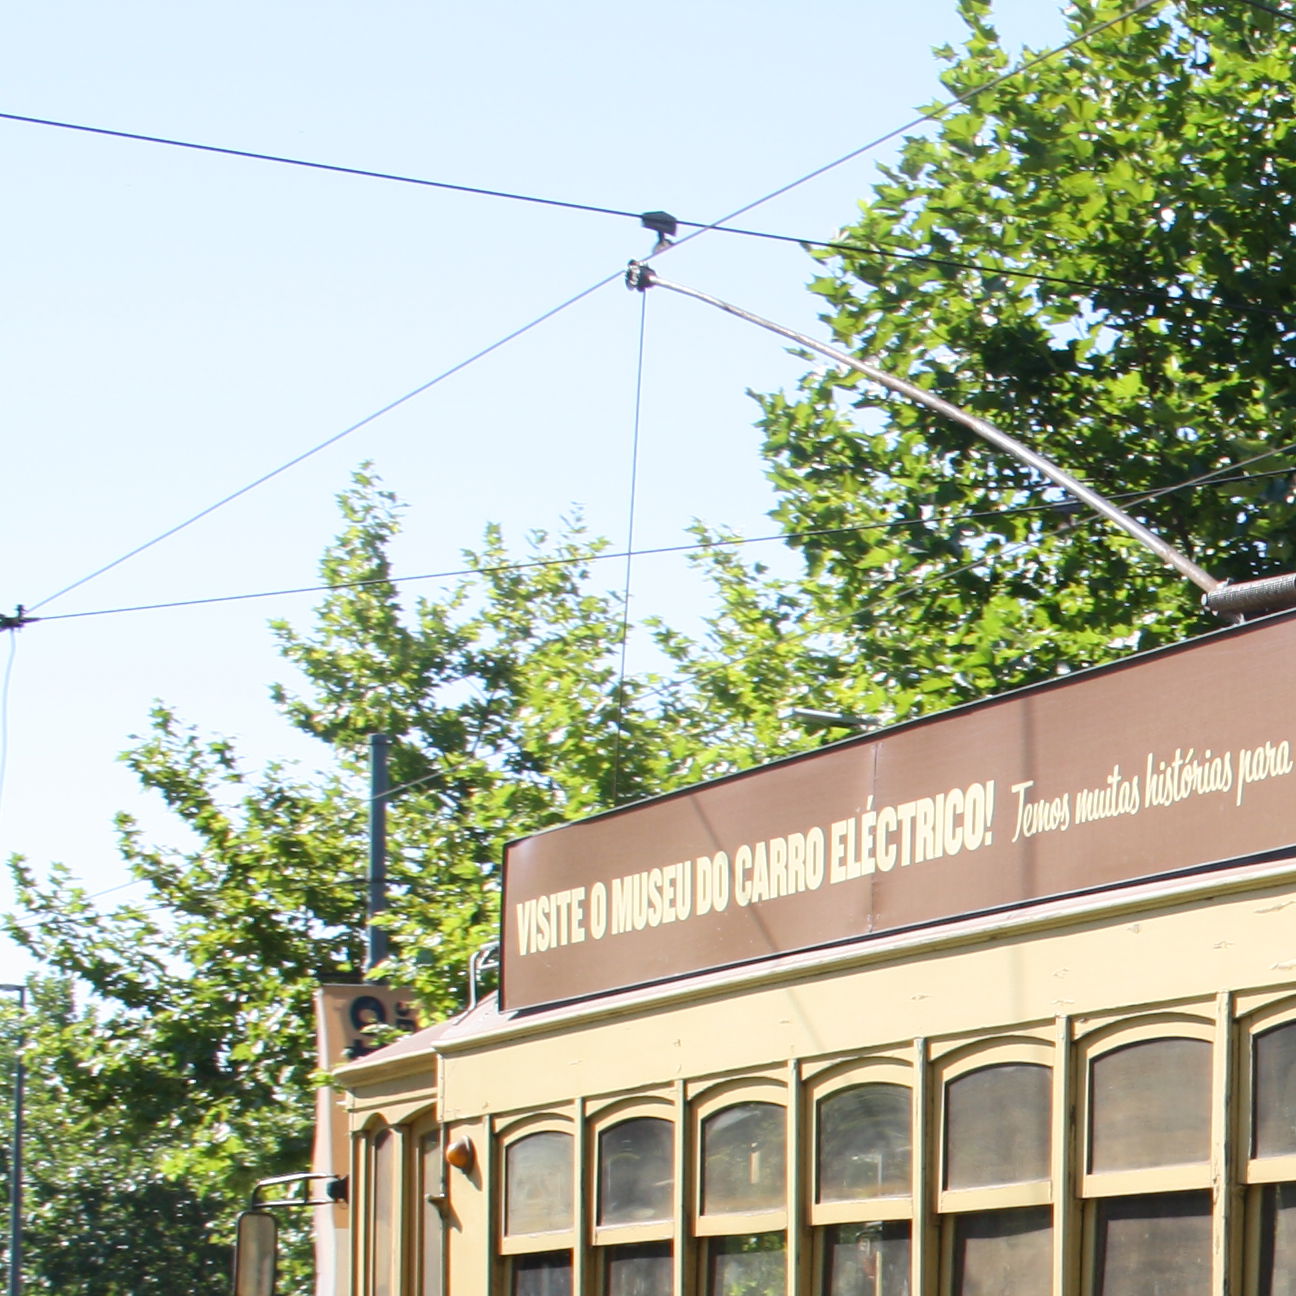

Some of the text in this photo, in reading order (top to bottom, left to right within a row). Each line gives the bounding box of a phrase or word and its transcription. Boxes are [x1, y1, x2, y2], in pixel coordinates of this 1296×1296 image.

[516, 886, 586, 956] VISITE
[590, 881, 607, 940] O
[611, 860, 693, 935] MUSEU
[696, 851, 730, 916] DO
[734, 826, 825, 907] CARRO
[830, 779, 996, 885] ELÉCTRICO!
[1011, 781, 1070, 843] Temos
[1075, 764, 1140, 824] muitas
[1144, 747, 1232, 809] histórias
[1236, 735, 1293, 806] para
